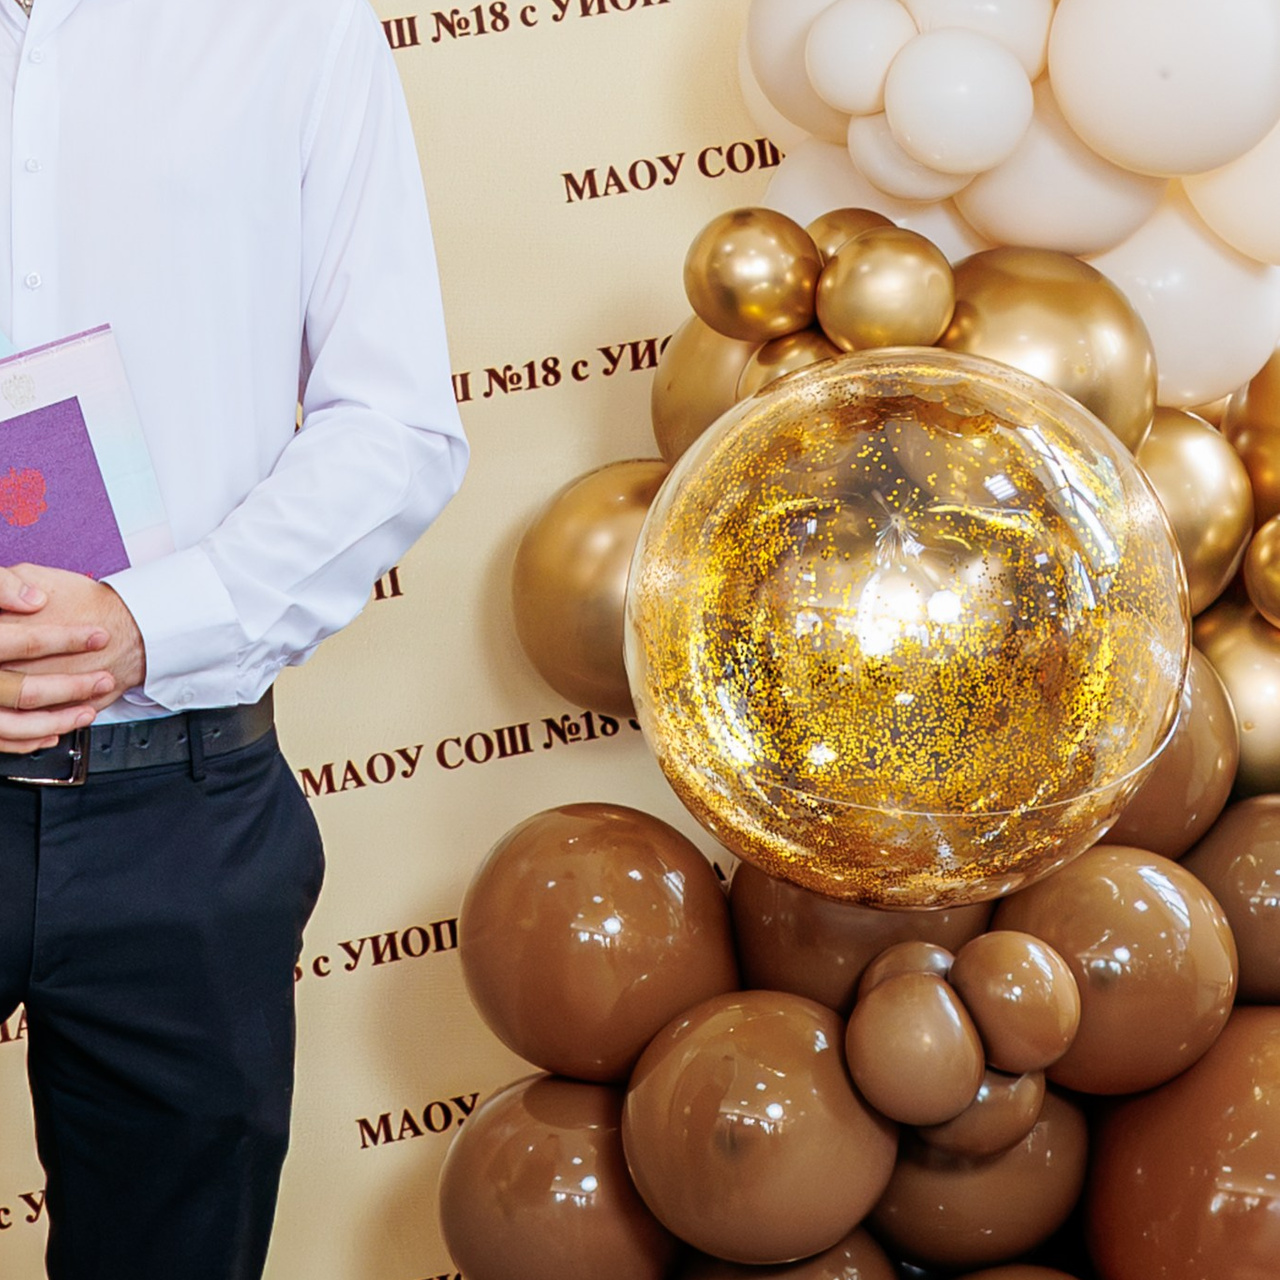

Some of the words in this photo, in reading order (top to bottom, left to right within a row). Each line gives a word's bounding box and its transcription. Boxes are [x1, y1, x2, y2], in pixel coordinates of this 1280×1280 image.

[431, 1, 510, 44] №18
[518, 4, 539, 29] с
[561, 152, 686, 204] МАОУ
[482, 356, 562, 399] №18
[570, 358, 591, 383] с
[596, 334, 673, 377] УИ
[298, 744, 424, 799] МАОУ
[435, 722, 534, 770] СОШ
[311, 954, 332, 979] с
[337, 917, 458, 972] УИОП
[355, 1092, 480, 1150] МАОУ
